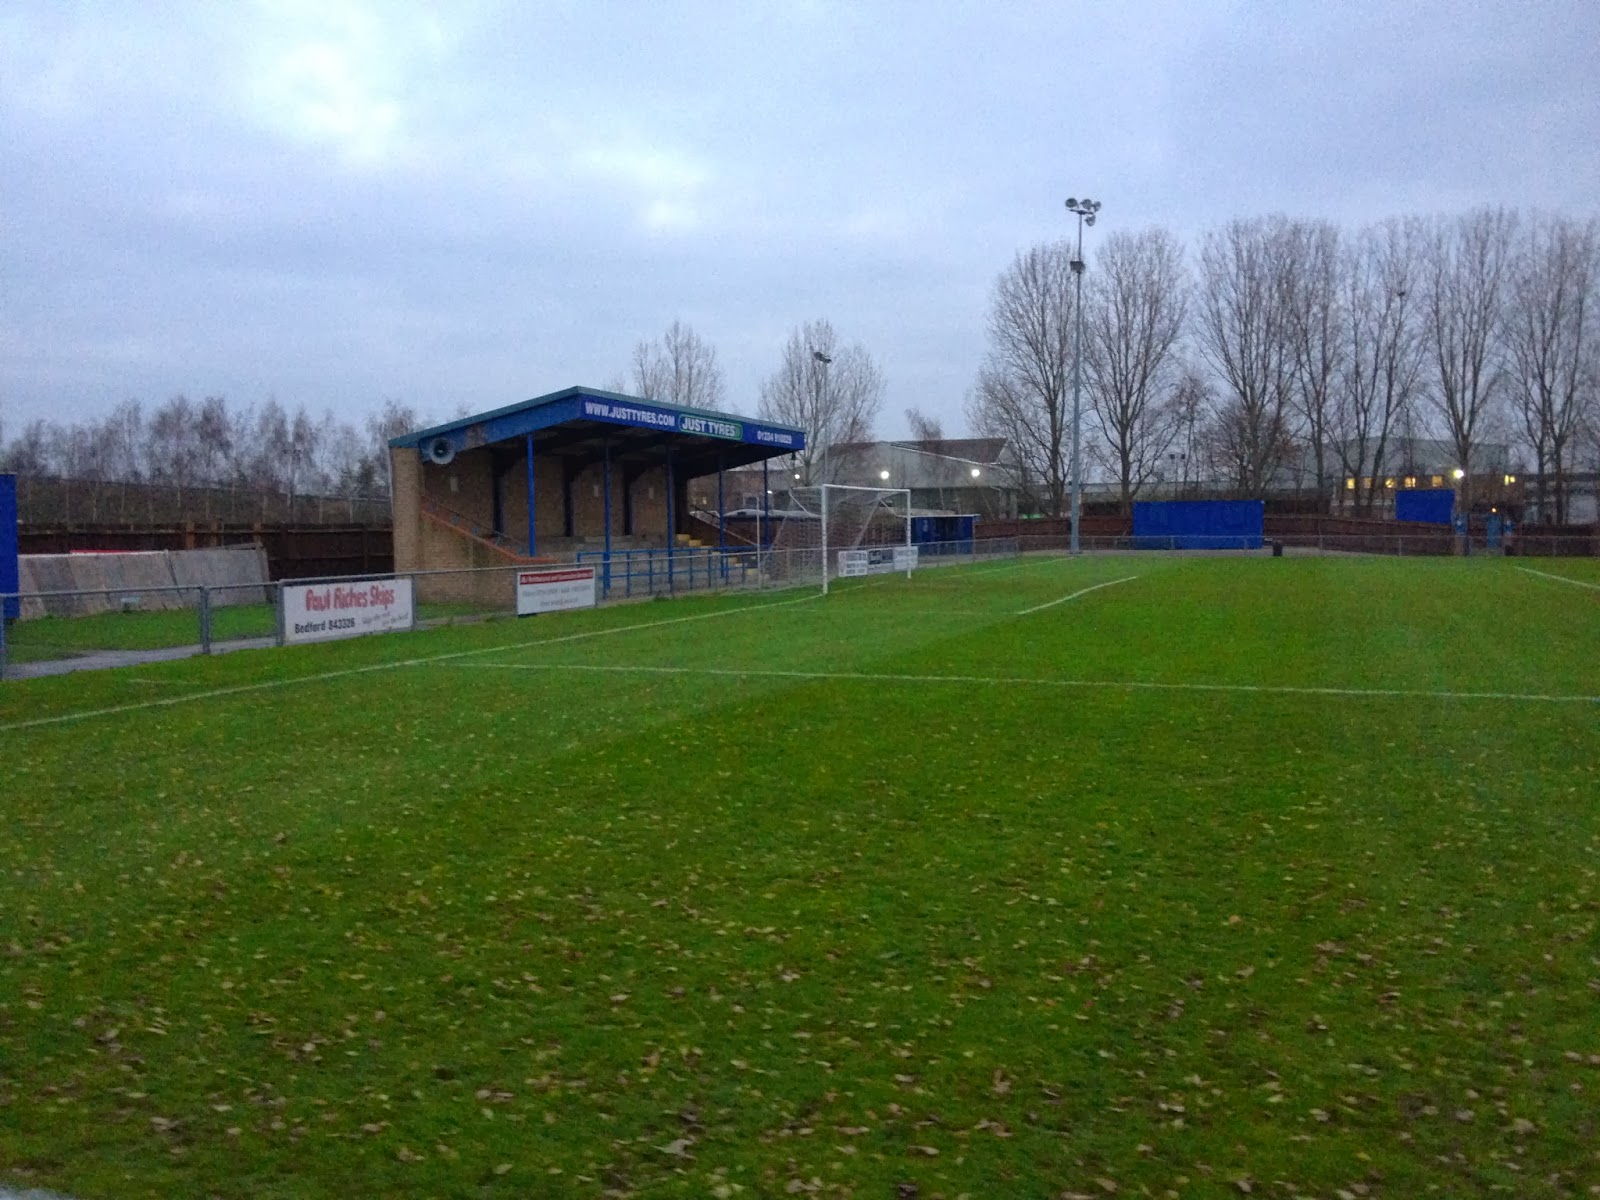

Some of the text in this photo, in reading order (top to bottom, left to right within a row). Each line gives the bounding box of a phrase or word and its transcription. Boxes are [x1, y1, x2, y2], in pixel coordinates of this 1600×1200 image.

[585, 402, 675, 426] WWW.JUSTTYRES.COM
[682, 417, 736, 437] JUST TYRES
[306, 585, 395, 612] Paul Riches Skips
[295, 620, 325, 633] Bedford
